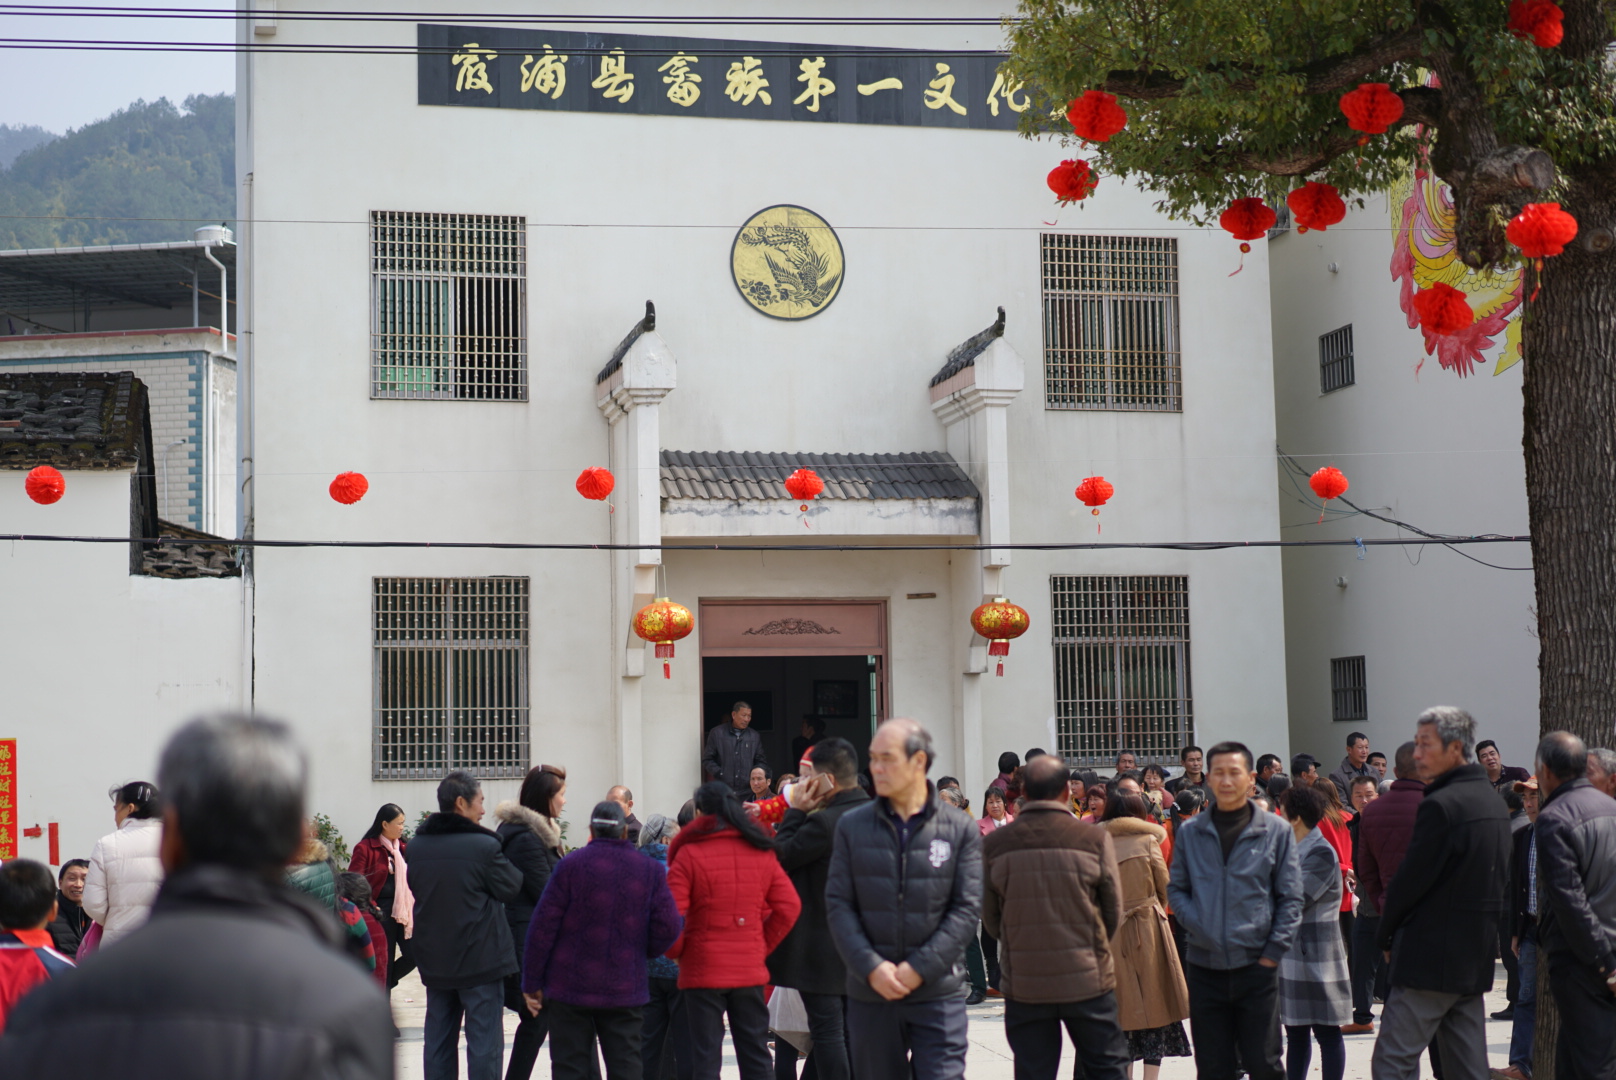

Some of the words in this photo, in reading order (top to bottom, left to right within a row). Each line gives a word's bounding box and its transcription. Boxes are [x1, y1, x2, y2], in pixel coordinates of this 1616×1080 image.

[451, 42, 1071, 122] 霞浦县畲族第一文化
